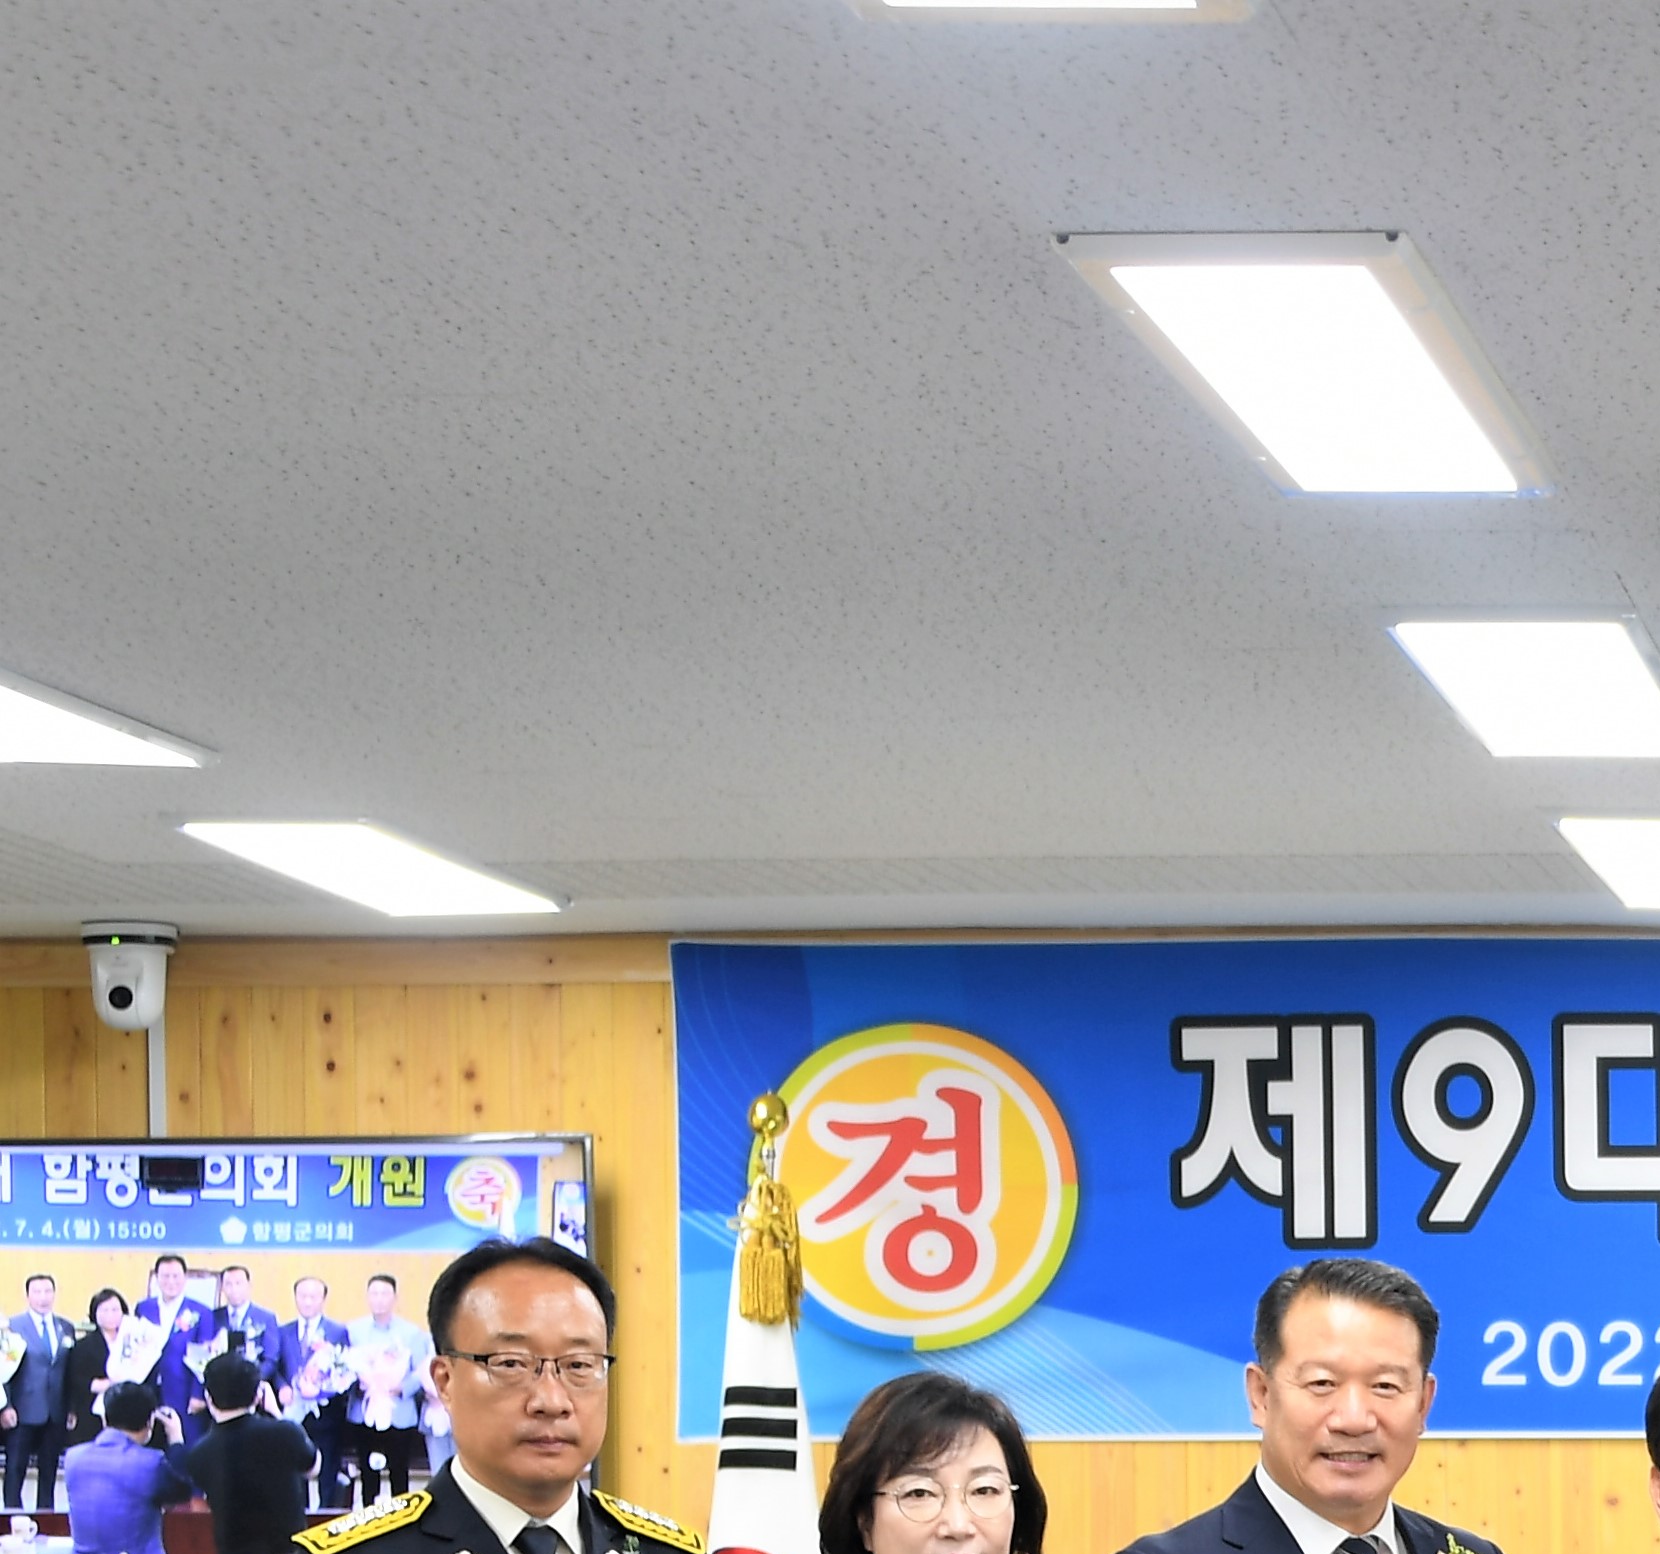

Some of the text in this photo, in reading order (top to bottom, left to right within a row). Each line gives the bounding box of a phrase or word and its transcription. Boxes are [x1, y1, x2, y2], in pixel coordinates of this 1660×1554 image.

[43, 1154, 298, 1209] 함평의회
[328, 1154, 425, 1208] 개원
[813, 1085, 986, 1294] 경
[107, 1220, 167, 1240] 15:00
